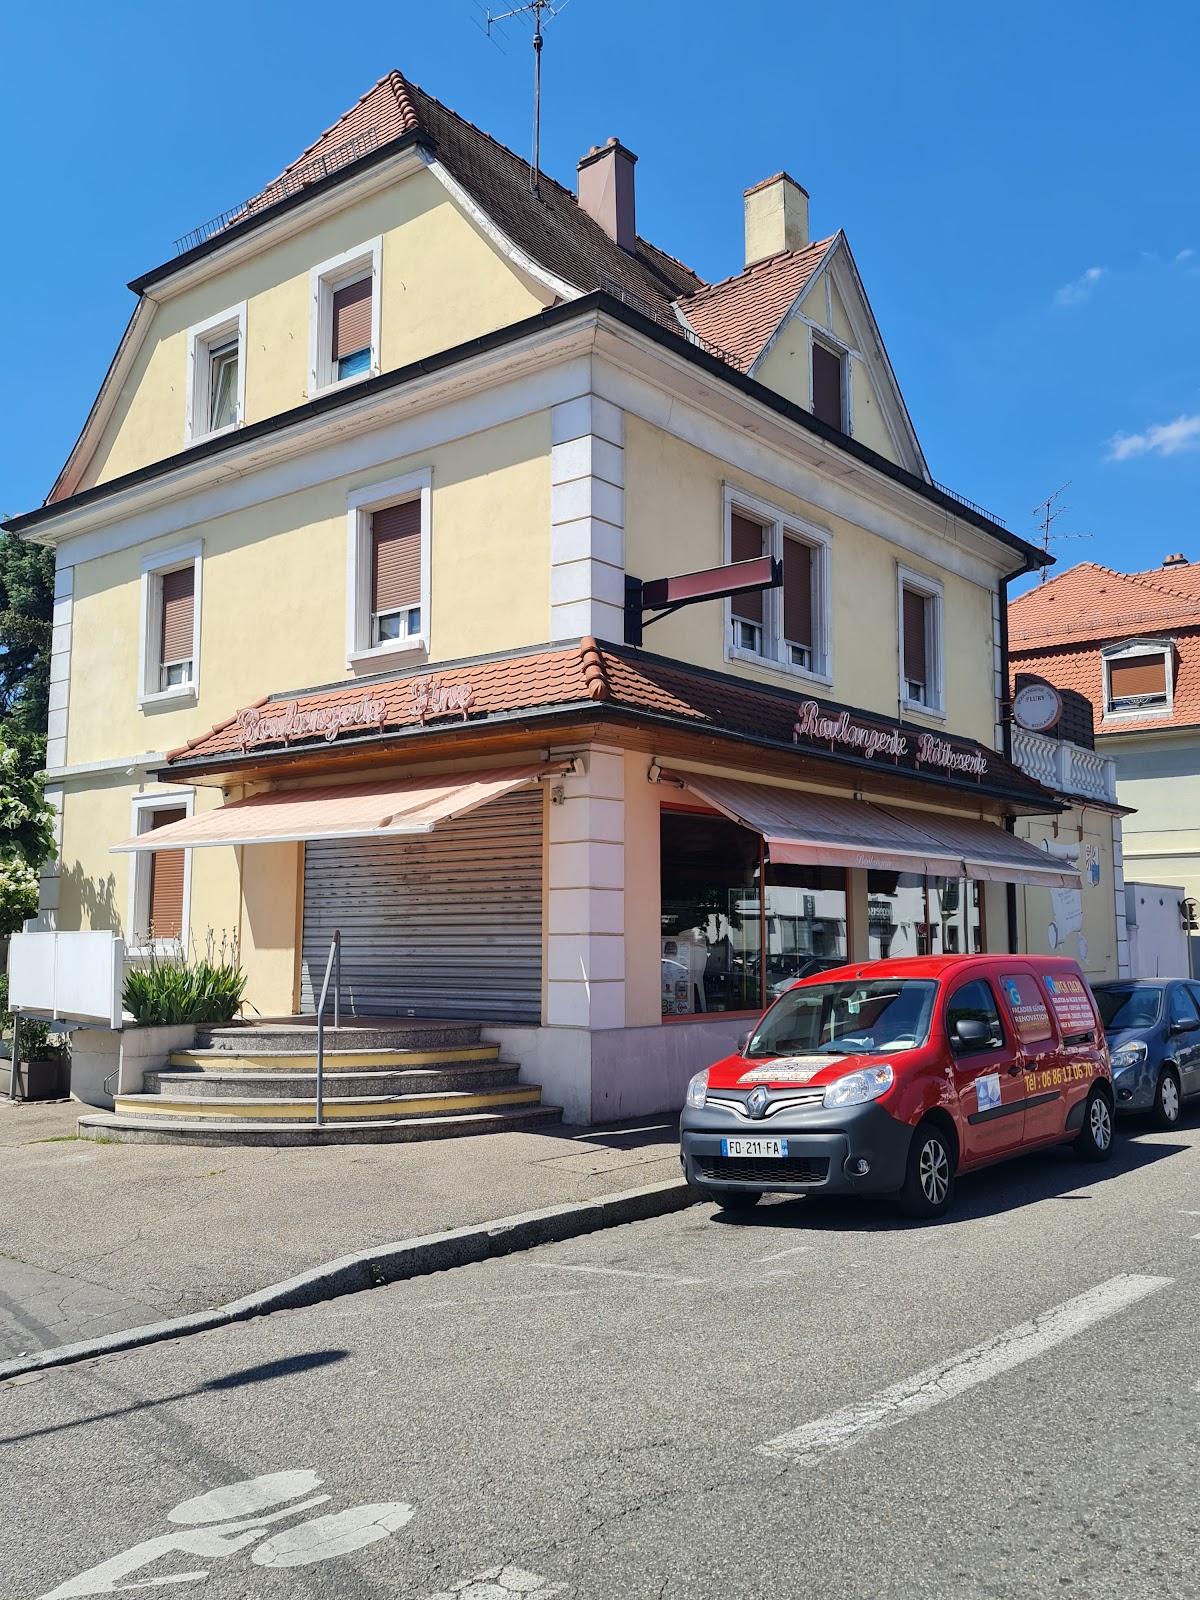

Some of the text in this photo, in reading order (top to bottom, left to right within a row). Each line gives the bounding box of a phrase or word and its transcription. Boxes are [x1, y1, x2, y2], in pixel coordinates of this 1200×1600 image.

[235, 675, 475, 743] Boulangerie Fine
[794, 700, 989, 775] Boulangerie Pâtisserie
[1014, 1013, 1049, 1023] RENOVATION
[1024, 1073, 1037, 1092] Tél
[1041, 1071, 1052, 1088] 06
[1052, 1068, 1062, 1085] 86
[1062, 1065, 1072, 1082] 17
[1072, 1063, 1083, 1080] 06
[1082, 1062, 1093, 1078] 70
